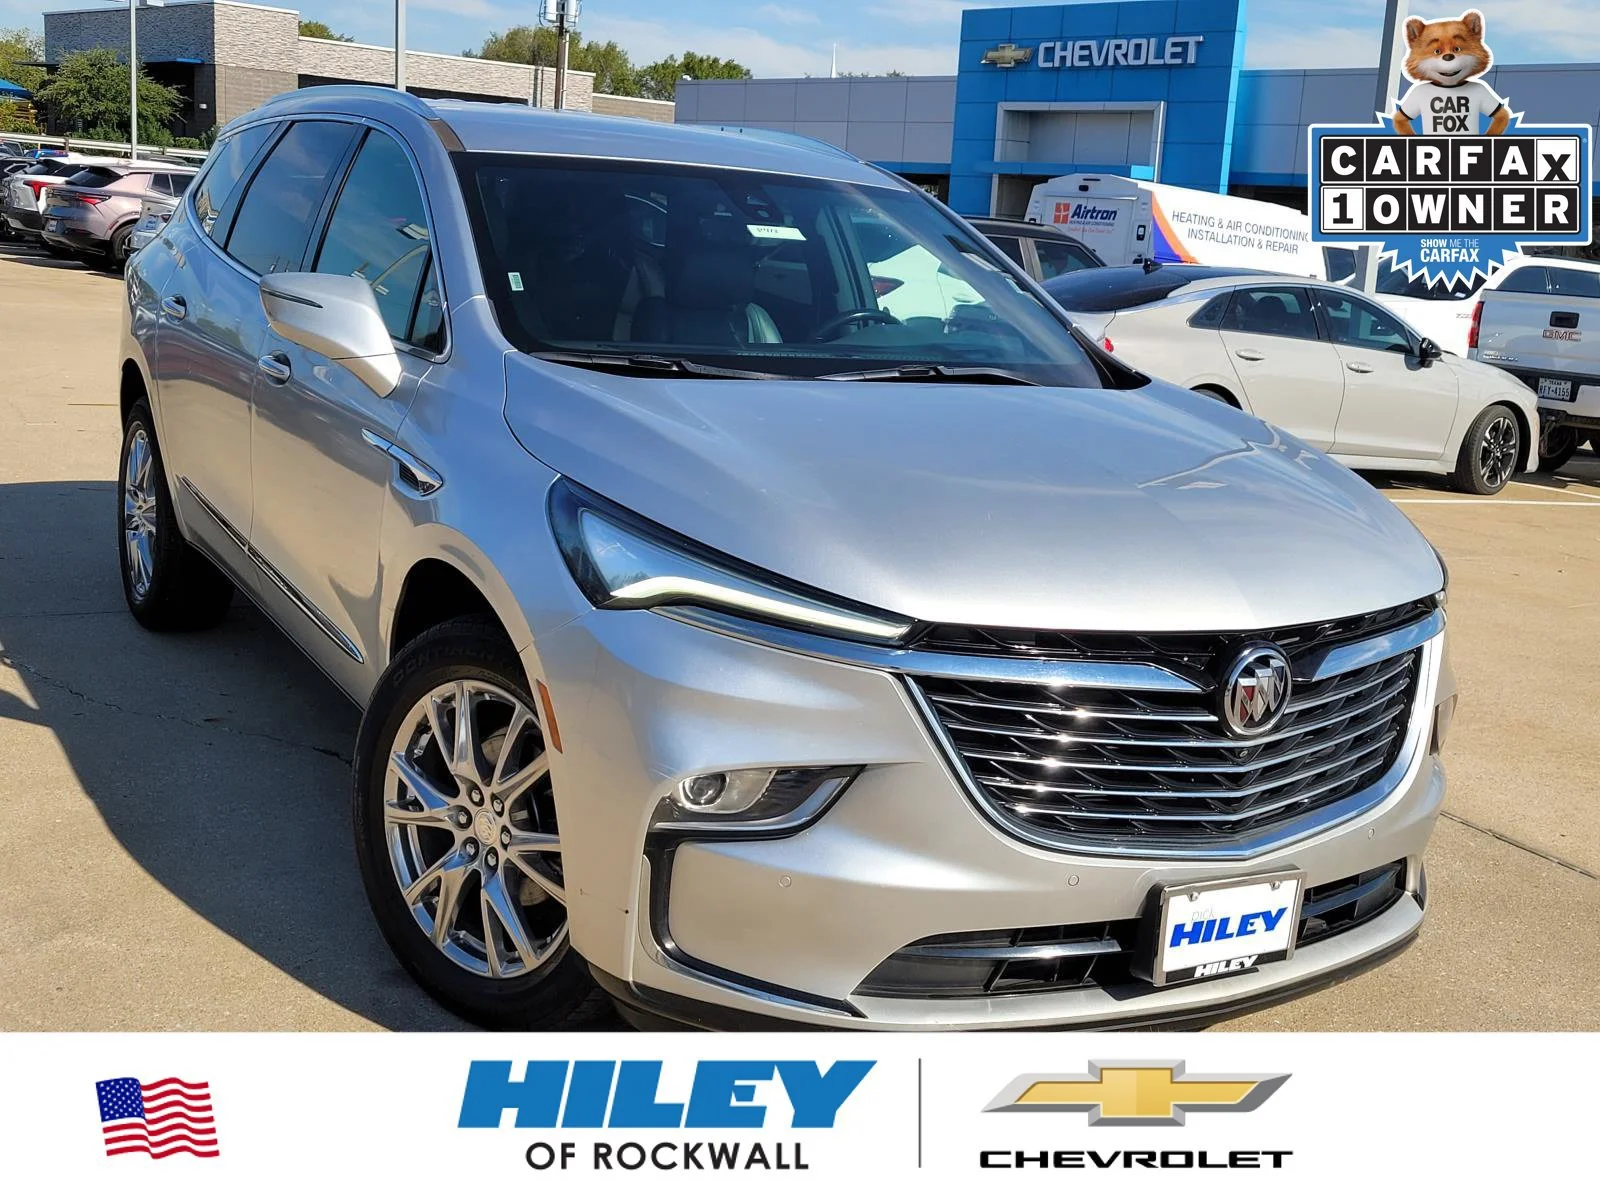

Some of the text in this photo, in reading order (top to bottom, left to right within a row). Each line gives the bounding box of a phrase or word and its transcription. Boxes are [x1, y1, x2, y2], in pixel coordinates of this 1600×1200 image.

[1038, 35, 1204, 68] CHEVROLET
[1071, 203, 1118, 220] Airtron
[1172, 210, 1215, 228] HEATING
[1218, 218, 1224, 229] &
[1227, 219, 1242, 233] AIR
[1187, 228, 1299, 254] INSTALLATION & REPAIR
[1543, 329, 1581, 342] GMC
[1170, 907, 1288, 948] HILEY
[1194, 955, 1259, 978] HILEY
